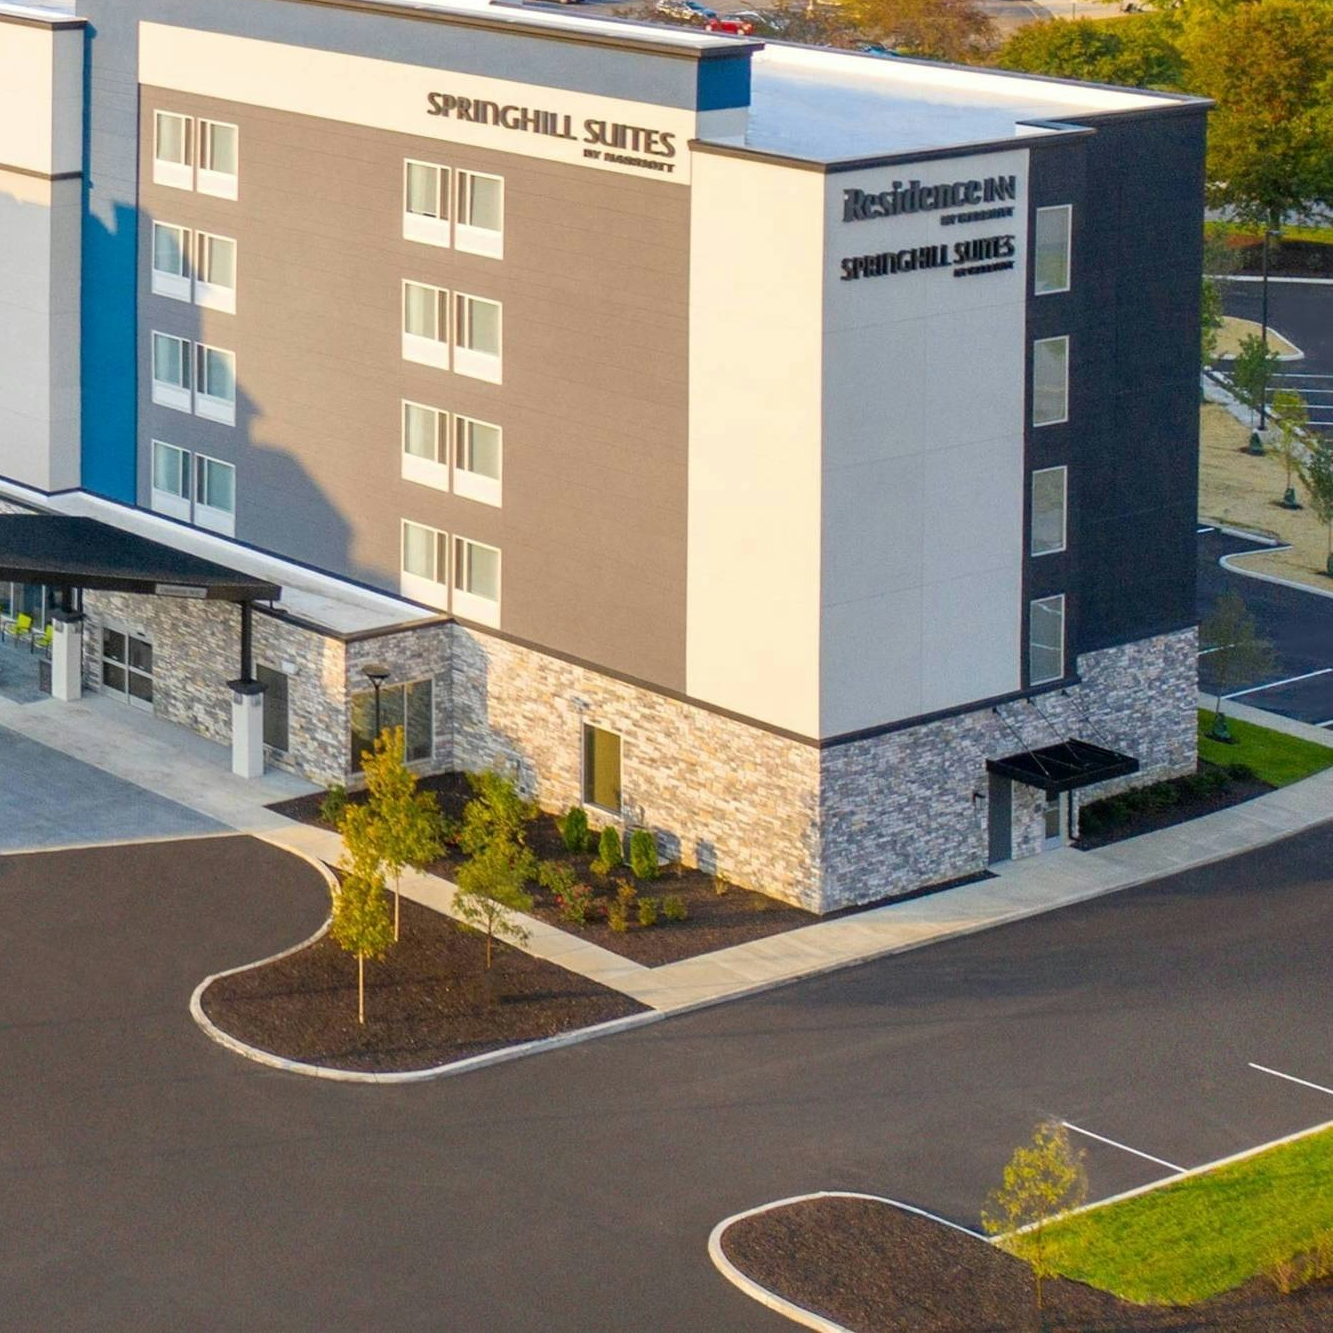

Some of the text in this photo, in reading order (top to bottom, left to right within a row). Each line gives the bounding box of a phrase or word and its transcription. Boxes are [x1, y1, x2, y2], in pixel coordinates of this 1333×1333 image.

[427, 92, 676, 158] SPRINGHILL SUITES
[842, 180, 982, 223] Residence
[983, 175, 1017, 203] INN
[840, 244, 952, 281] SPRINGHILL
[953, 234, 1016, 265] SUITES
